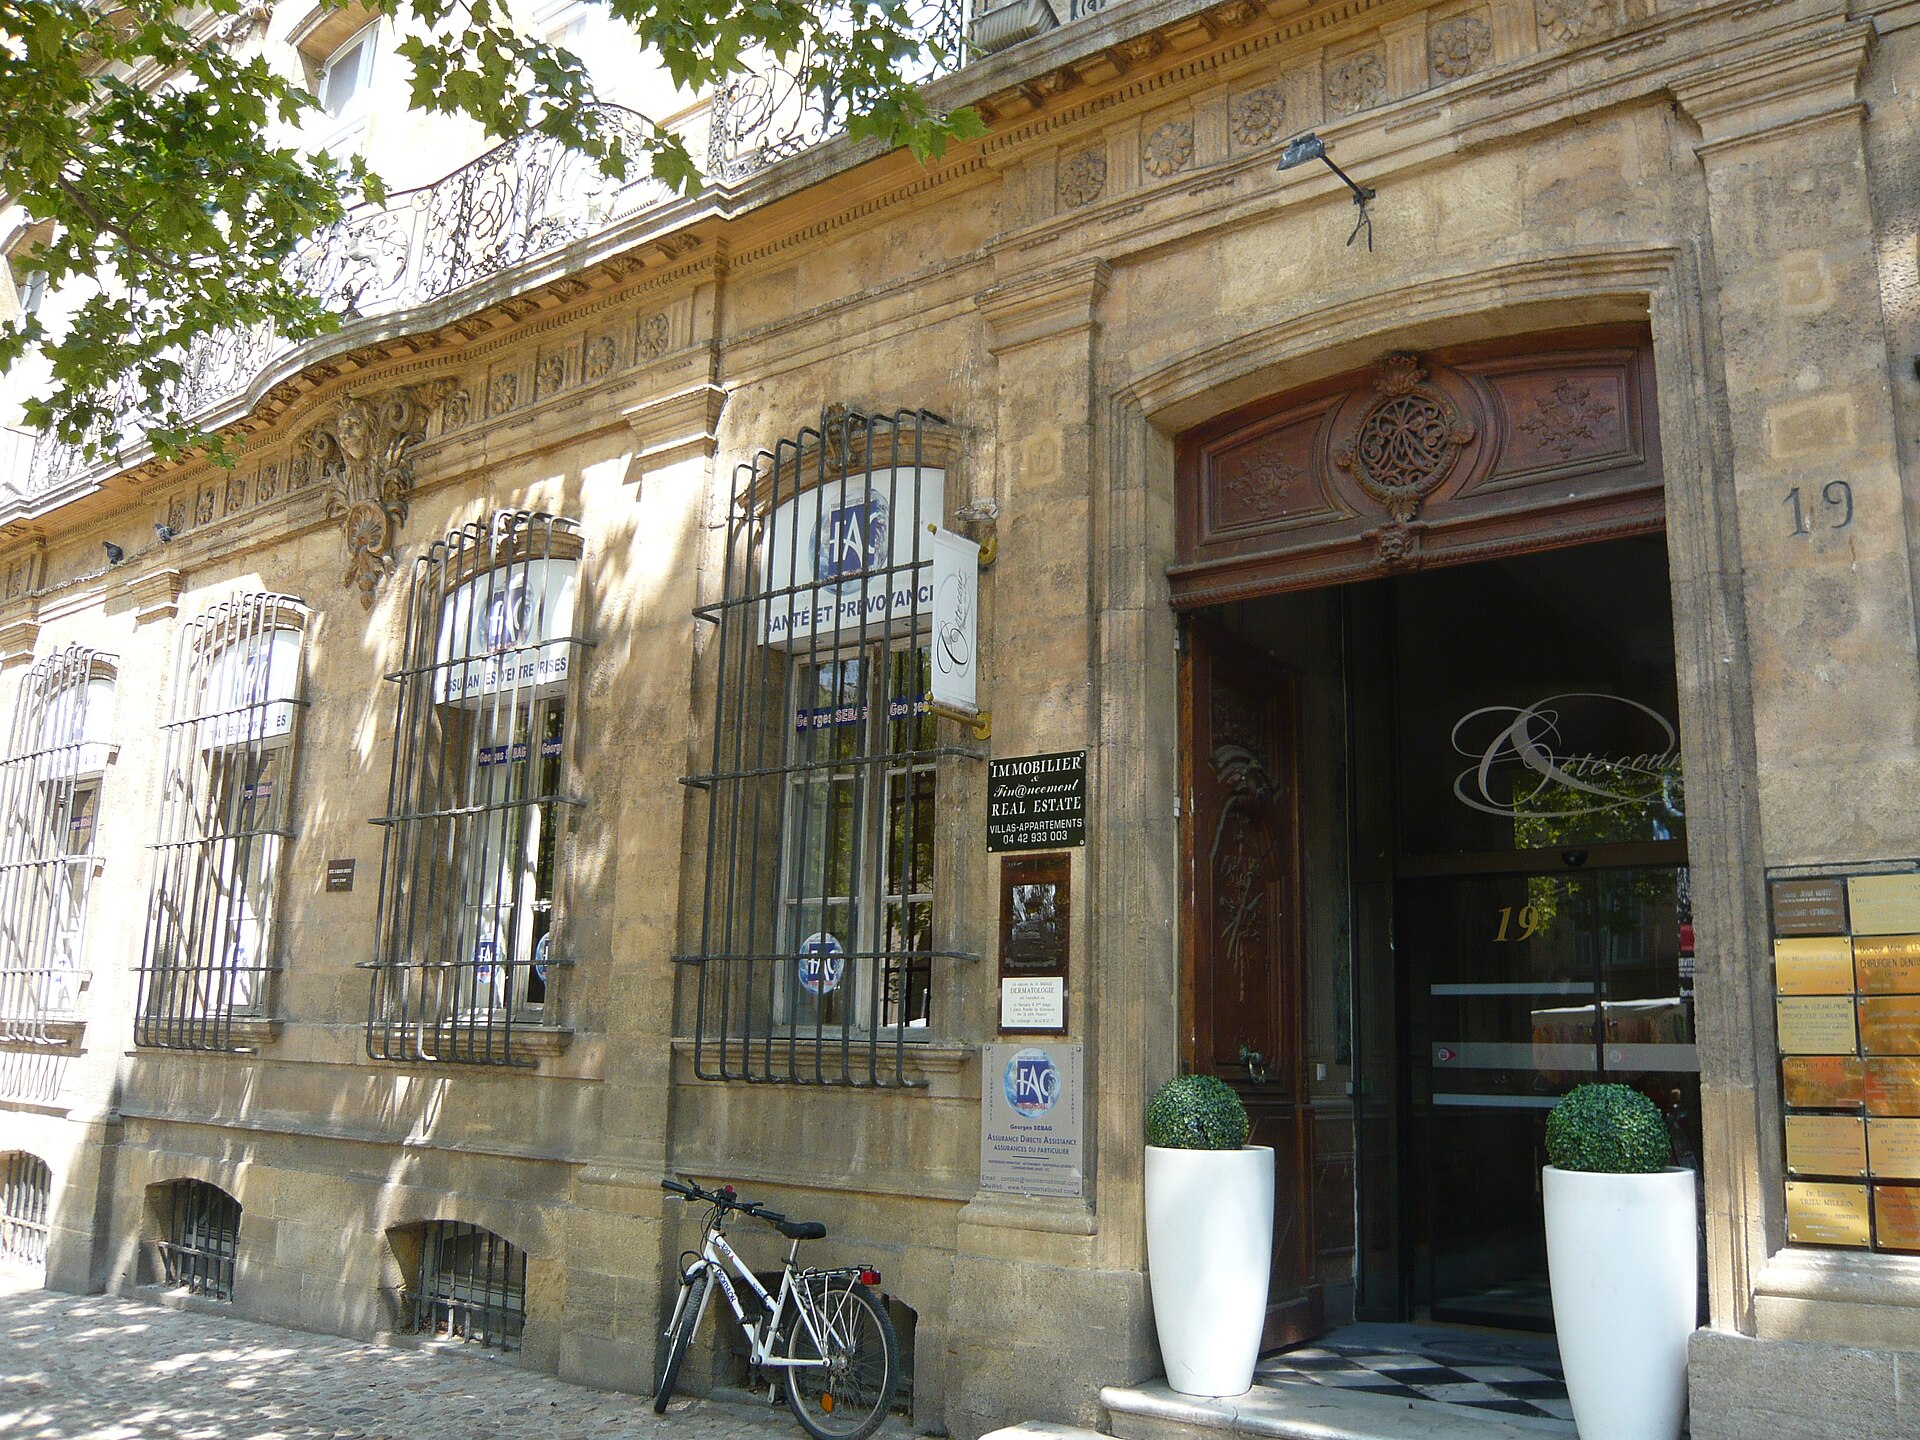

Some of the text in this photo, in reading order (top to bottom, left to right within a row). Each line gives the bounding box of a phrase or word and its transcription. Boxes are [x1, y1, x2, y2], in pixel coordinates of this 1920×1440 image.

[1783, 480, 1853, 538] 19
[816, 605, 833, 623] ET
[840, 584, 932, 617] PRVOYANC
[443, 656, 567, 694] SUANES D'ETRERISES
[889, 700, 929, 718] Geoge
[797, 713, 832, 729] Gerges
[992, 756, 1082, 778] IMMOBILIER
[993, 779, 1079, 798] Fin@ncement
[992, 796, 1081, 817] REAL ESTATE
[990, 818, 1083, 834] VILLAS-APPARTEMENTS
[1003, 830, 1068, 845] 04 42 933 003
[1491, 905, 1539, 942] 19
[993, 1144, 1027, 1153] ASSURANCES
[1037, 1147, 1070, 1155] PARTICULIER
